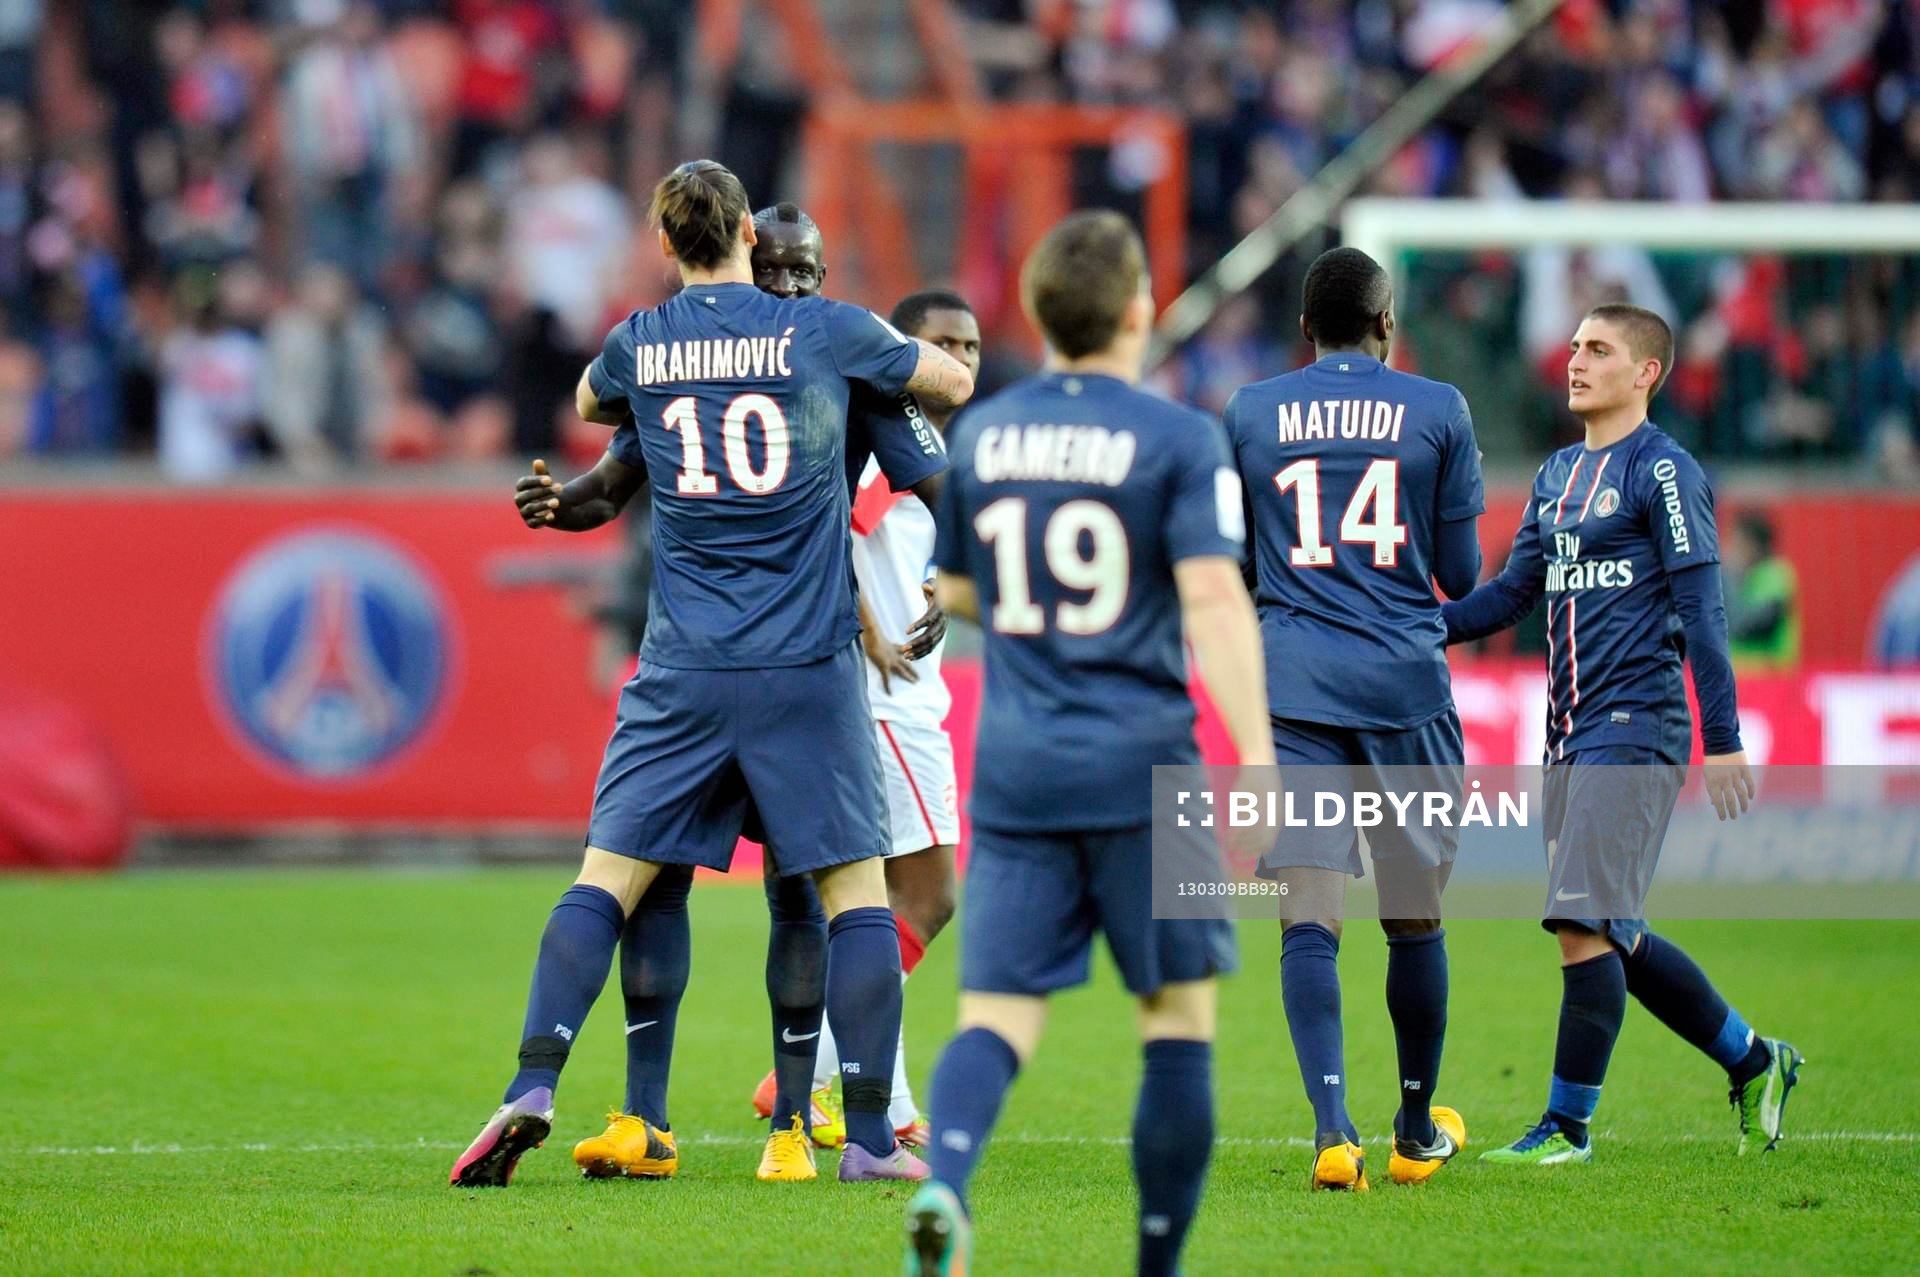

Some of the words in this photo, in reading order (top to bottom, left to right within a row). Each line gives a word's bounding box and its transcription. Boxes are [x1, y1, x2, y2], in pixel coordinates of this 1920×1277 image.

[636, 328, 794, 386] IBRAHIMOVIĆ
[1278, 400, 1405, 443] MATUIDI
[661, 393, 791, 497] 10
[1273, 458, 1408, 567] 14
[1554, 531, 1580, 562] Fly
[972, 497, 1131, 635] 19
[554, 1023, 573, 1041] PSG
[841, 1062, 860, 1074] PSG
[1323, 1074, 1340, 1085] PSG
[1404, 1079, 1421, 1090] PSG
